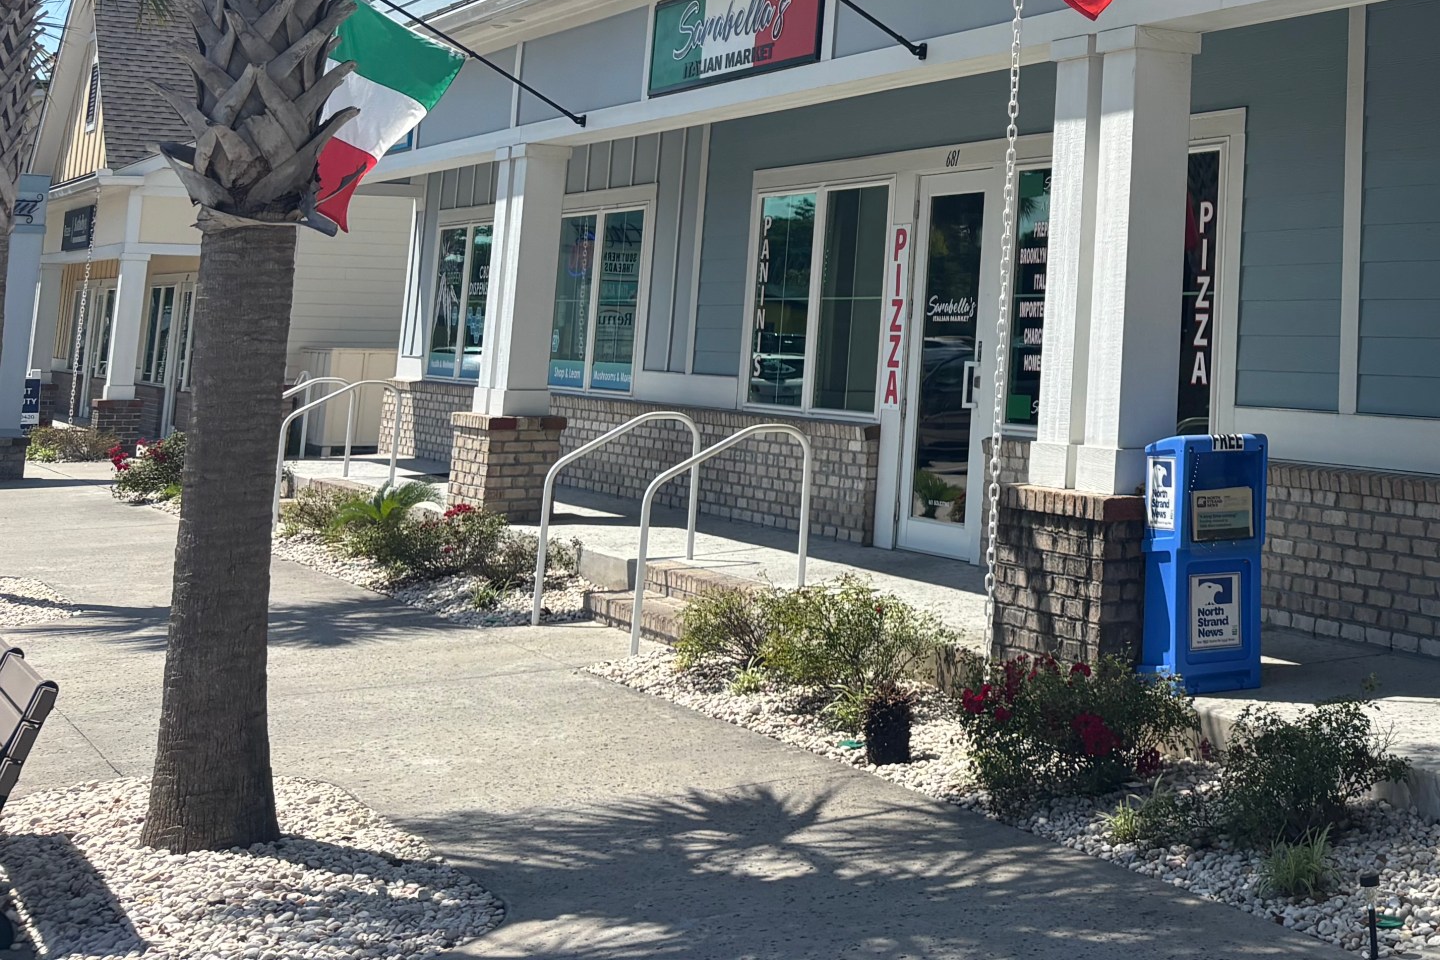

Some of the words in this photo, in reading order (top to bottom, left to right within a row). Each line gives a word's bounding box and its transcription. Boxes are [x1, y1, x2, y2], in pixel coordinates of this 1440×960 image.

[683, 54, 723, 79] ITALIAN
[724, 43, 775, 69] MARKET
[946, 149, 960, 168] 681
[753, 215, 773, 377] PANINIS
[1190, 201, 1214, 385] PIZZA
[927, 295, 976, 318] Sarabella's
[884, 228, 907, 405] PIZZA
[1212, 434, 1243, 450] FREE
[1152, 498, 1170, 509] Strand
[1197, 606, 1225, 617] North
[1197, 615, 1229, 627] Strand
[1198, 627, 1224, 638] News
